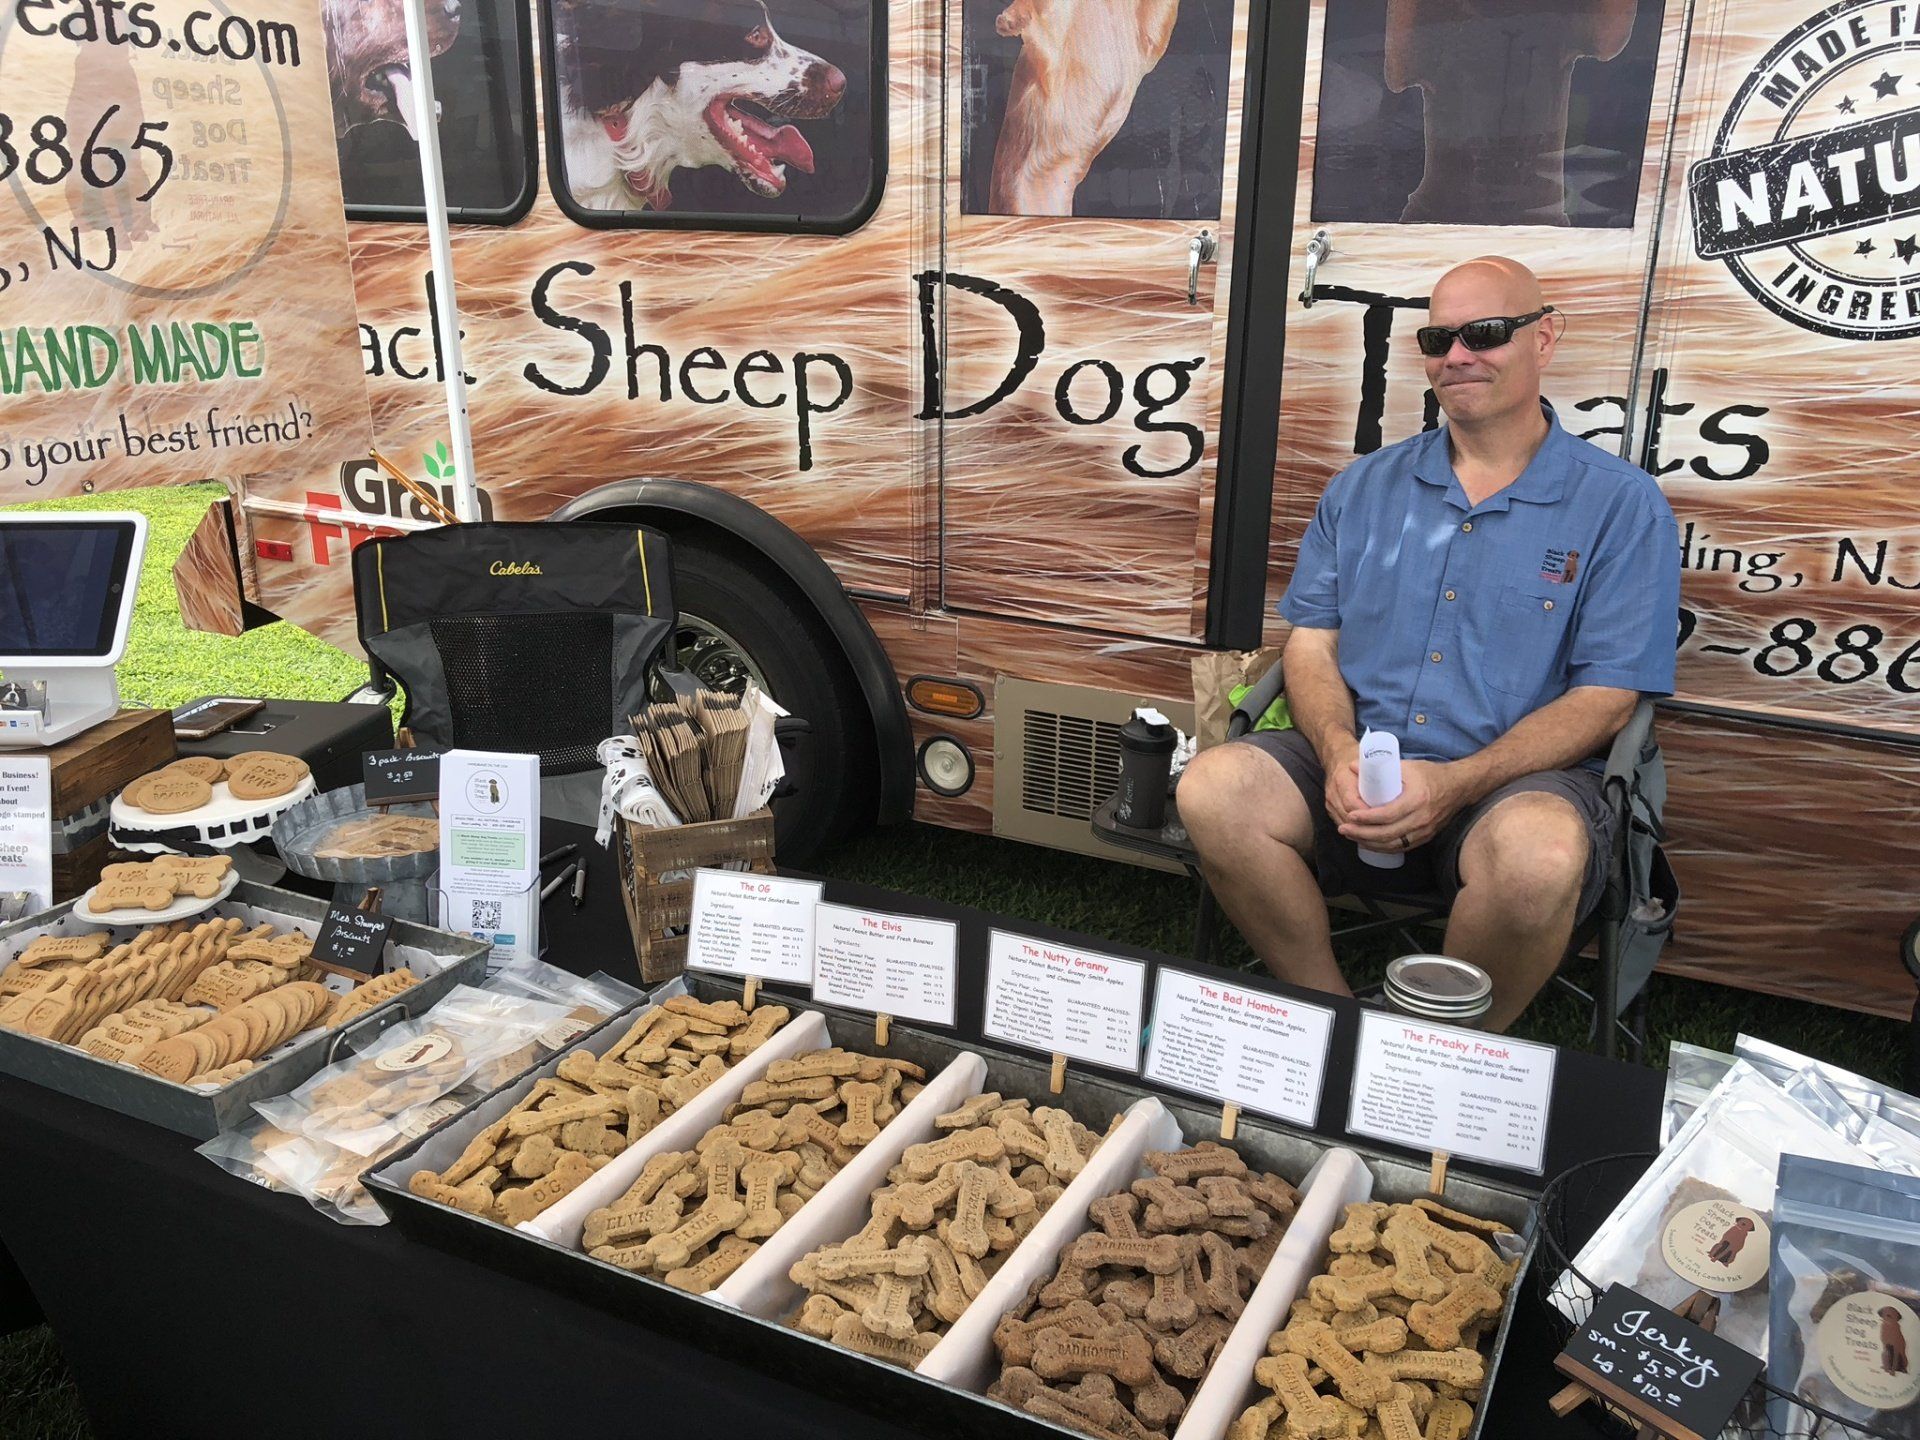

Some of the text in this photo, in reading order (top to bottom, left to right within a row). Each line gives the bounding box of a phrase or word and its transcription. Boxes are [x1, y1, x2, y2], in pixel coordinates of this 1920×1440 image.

[1760, 15, 1871, 110] MADE
[43, 226, 116, 271] NJ
[128, 321, 263, 385] MADE
[359, 260, 1770, 481] ack Sheep Dog Tats
[25, 436, 112, 487] your
[119, 413, 201, 457] best
[207, 402, 314, 448] friend?
[369, 755, 376, 765] 3
[3, 771, 39, 779] Business!
[13, 811, 45, 820] stamped
[740, 882, 771, 893] The OG
[862, 918, 902, 932] The Elvis
[1008, 954, 1028, 964] Natural
[1022, 945, 1109, 974] The Nutty Granny
[1176, 993, 1198, 1004] Natural
[1200, 999, 1219, 1009] Peanut
[1244, 1011, 1265, 1022] Granny
[1266, 1017, 1285, 1026] Smith
[1199, 985, 1289, 1017] The Bad Hombre
[1250, 1022, 1261, 1030] and
[1381, 1039, 1405, 1050] Natural
[1406, 1045, 1427, 1054] Peanut
[1456, 1055, 1482, 1066] Smoked
[1402, 1029, 1510, 1059] The Freaky Freak
[1415, 1056, 1438, 1067] Granny
[1440, 1061, 1459, 1071] Smith
[1485, 1070, 1498, 1078] and
[805, 1117, 839, 1141] ELVI
[714, 1162, 730, 1196] ELVI
[1706, 1208, 1731, 1227] Sheep
[1713, 1202, 1735, 1218] Black
[606, 1210, 654, 1230] ELVIS
[1699, 1215, 1716, 1230] Dog
[1693, 1223, 1718, 1241] Treats
[609, 1249, 647, 1264] ELV
[1847, 1302, 1874, 1314] Black
[1846, 1313, 1878, 1329] Sheep
[1613, 1310, 1720, 1388] Jerky
[1845, 1336, 1879, 1350] Treats
